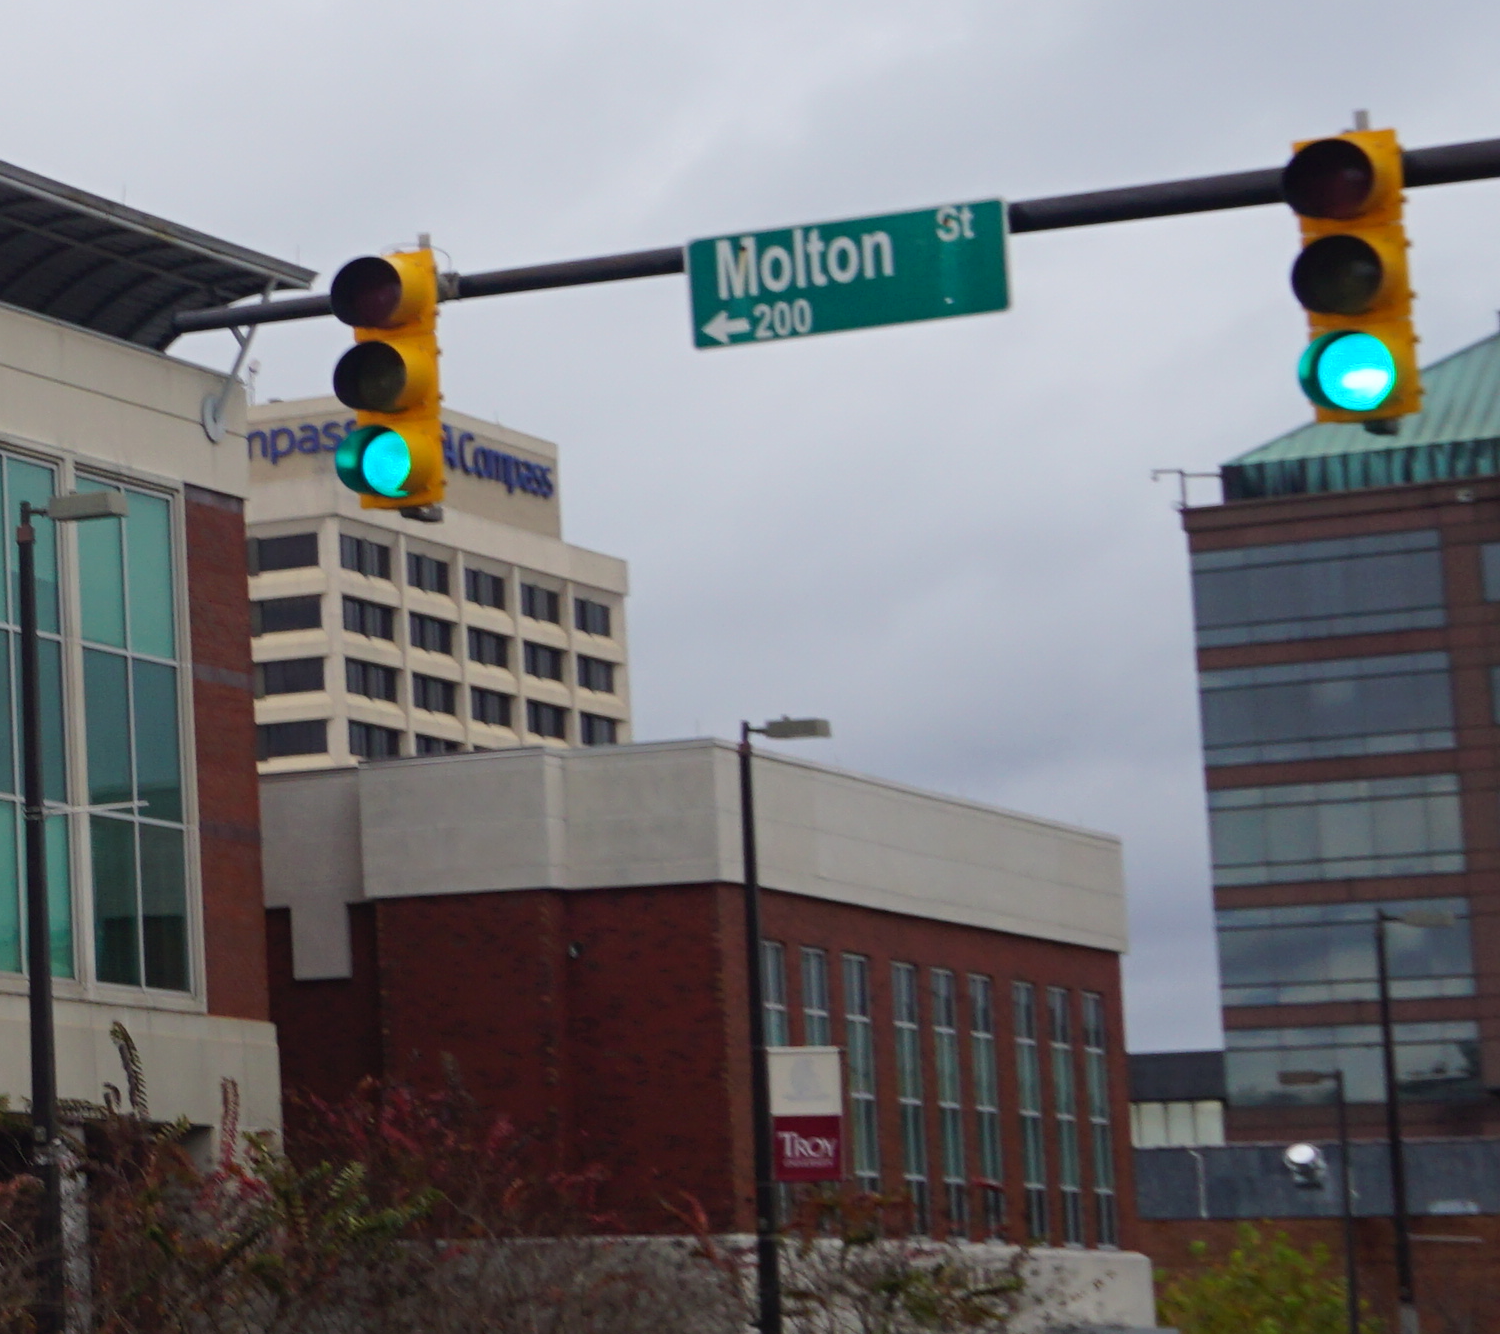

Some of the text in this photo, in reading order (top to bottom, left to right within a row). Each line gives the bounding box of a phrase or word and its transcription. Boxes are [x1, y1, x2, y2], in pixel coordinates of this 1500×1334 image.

[715, 206, 976, 301] Molton St
[753, 298, 813, 340] 200
[459, 432, 553, 500] Compass
[777, 1130, 838, 1158] TROY
